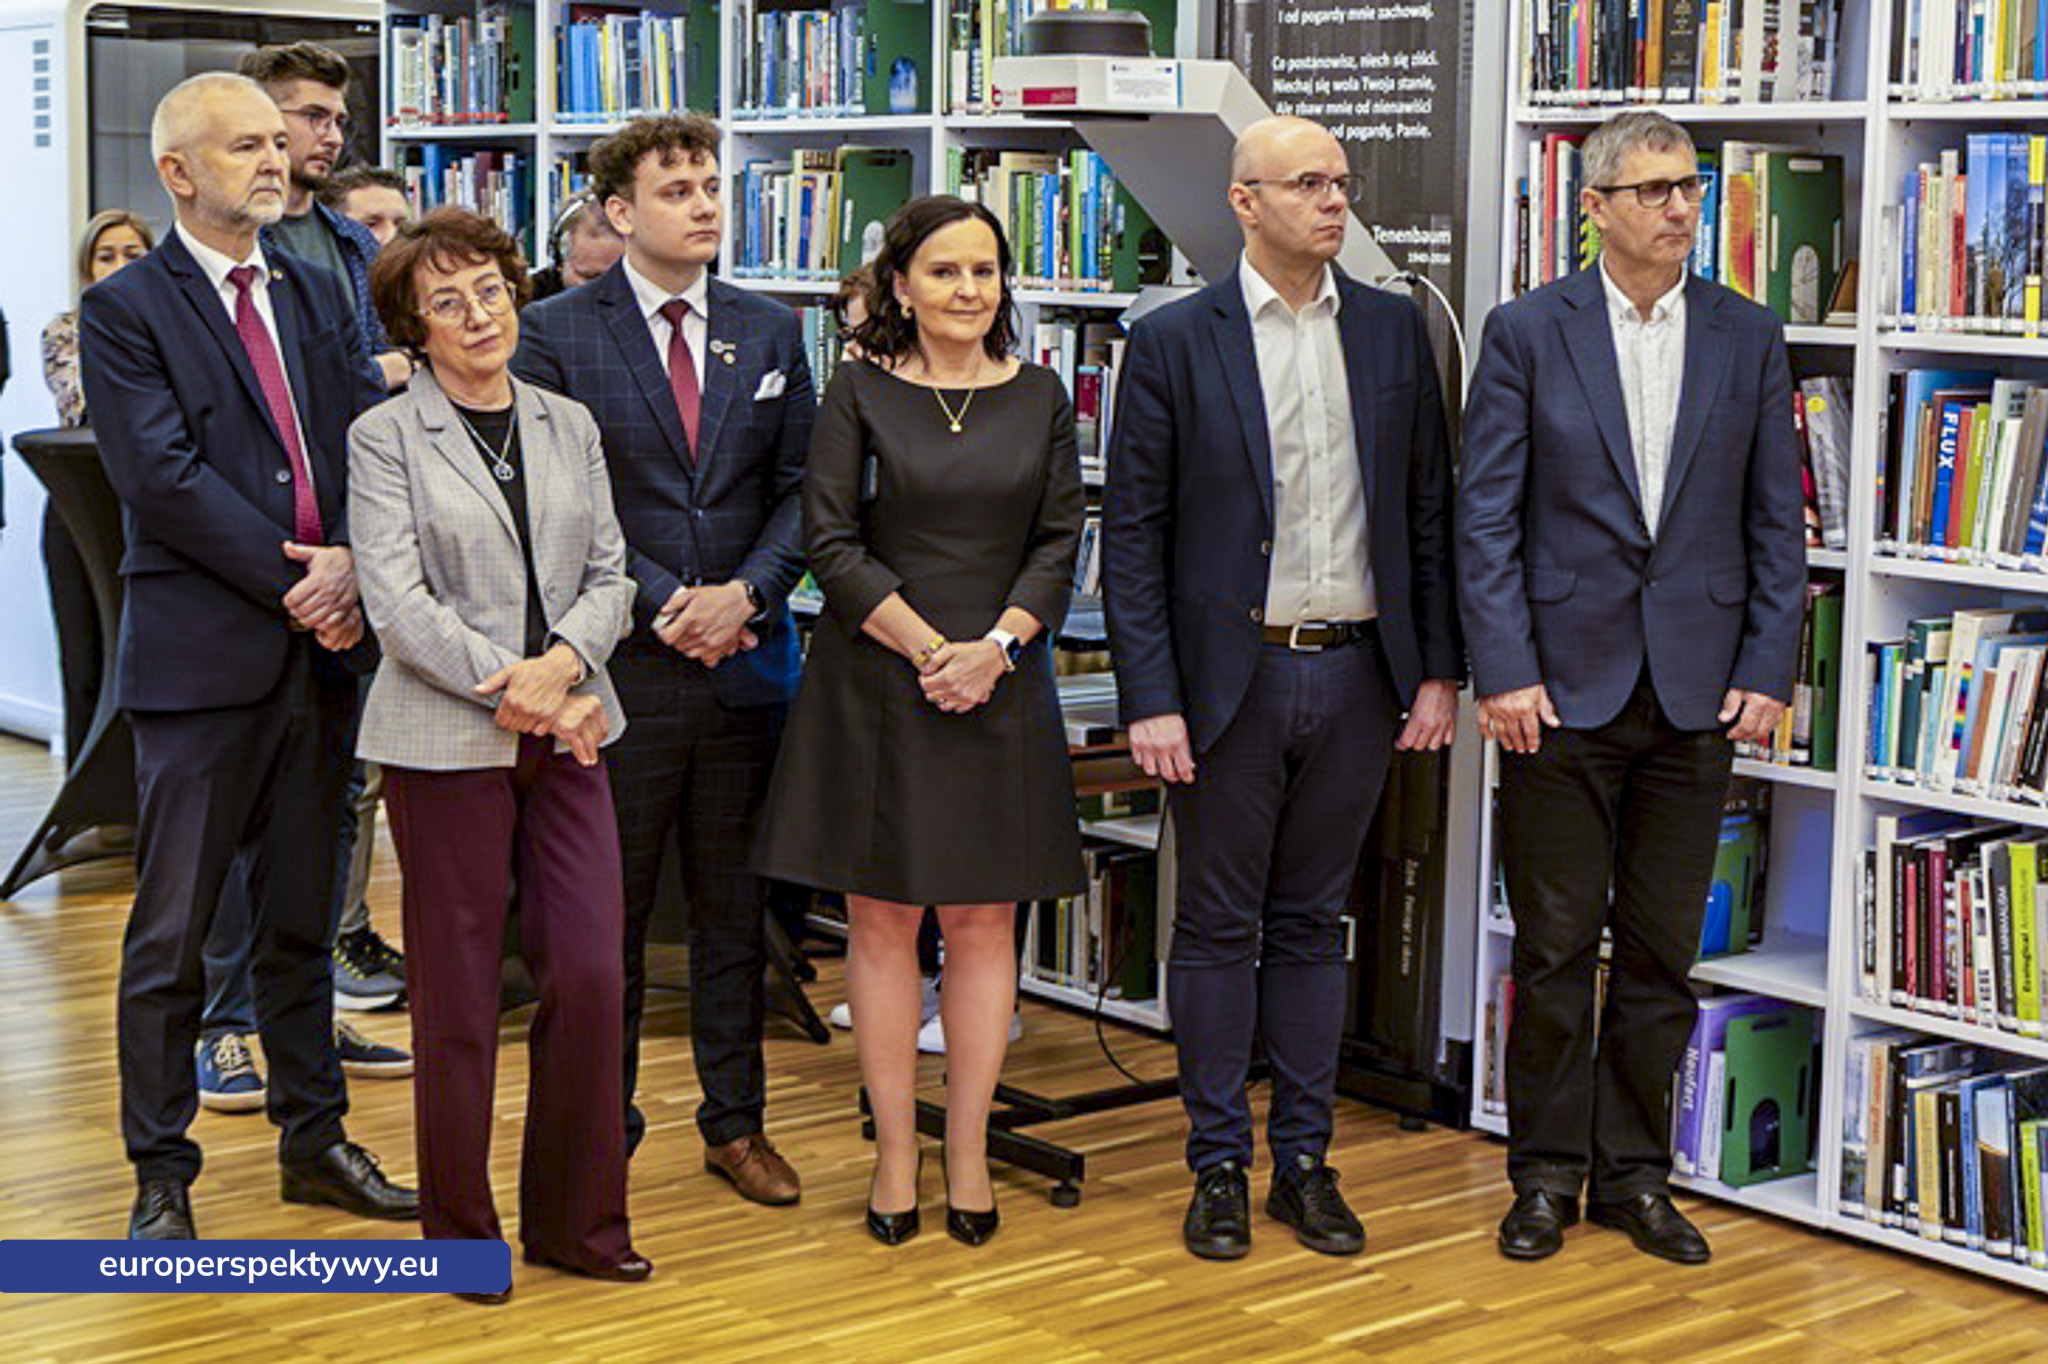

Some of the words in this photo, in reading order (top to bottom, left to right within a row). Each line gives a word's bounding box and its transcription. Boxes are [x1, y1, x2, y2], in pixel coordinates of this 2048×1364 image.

[1284, 8, 1299, 24] od
[1301, 6, 1345, 27] pogardy
[1347, 5, 1376, 21] mnie
[1272, 55, 1286, 71] Co
[1360, 51, 1390, 68] niech
[1393, 51, 1409, 71] się
[1272, 77, 1314, 96] Niechaj
[1315, 77, 1330, 94] się
[1332, 76, 1360, 91] wola
[1362, 76, 1395, 93] Twoja
[1326, 100, 1353, 114] mnie
[1355, 99, 1371, 114] od
[1396, 122, 1432, 139] Panie.
[1371, 225, 1452, 245] Tenenbaum
[1937, 412, 1960, 469] FLUX
